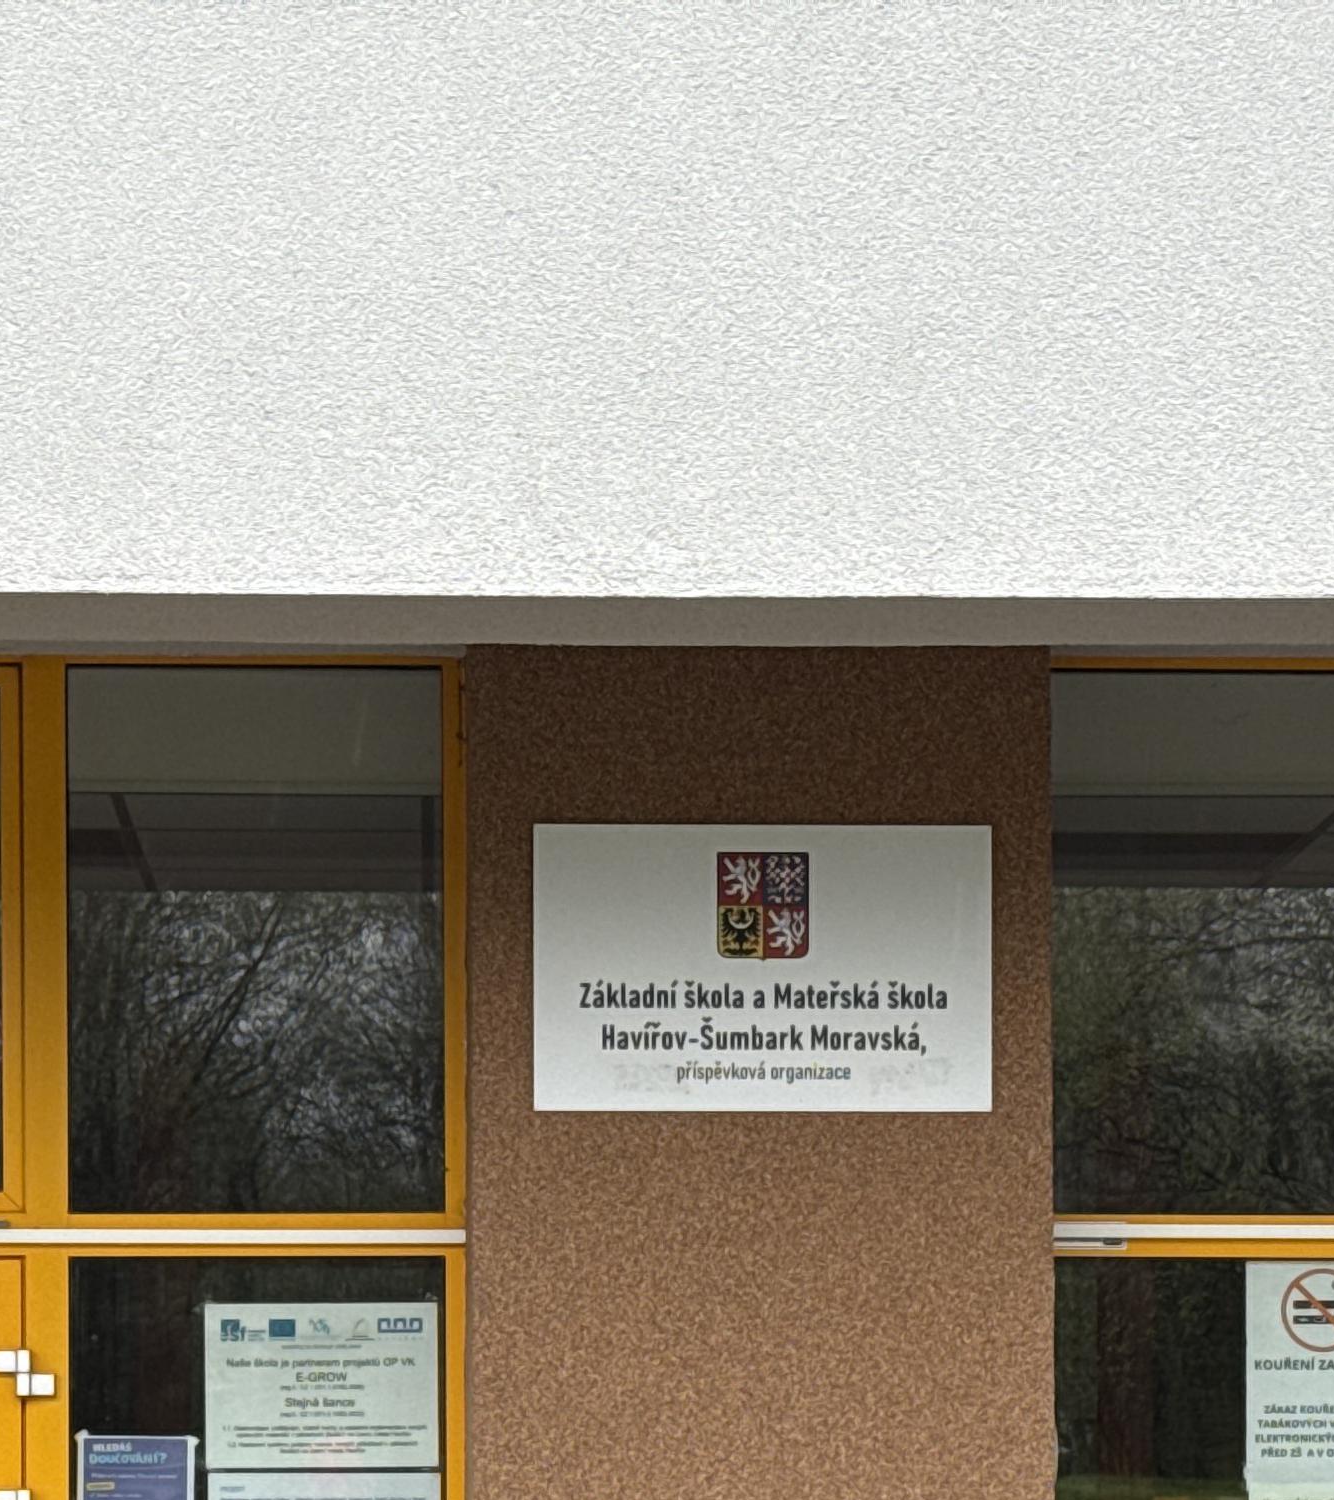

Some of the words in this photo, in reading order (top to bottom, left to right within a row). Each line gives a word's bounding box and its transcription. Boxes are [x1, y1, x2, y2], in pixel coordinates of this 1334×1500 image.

[579, 980, 677, 1010] Základní
[683, 980, 744, 1010] škola
[753, 988, 766, 1010] a
[774, 980, 878, 1010] Mateřská
[887, 980, 948, 1010] škola
[601, 1017, 802, 1052] Havířov-Šumbark
[811, 1022, 927, 1056] Moravská,
[677, 1060, 766, 1083] příspěvková
[771, 1064, 851, 1084] organizace
[226, 1358, 252, 1368] Naše
[253, 1358, 279, 1368] škola
[280, 1358, 290, 1369] je
[292, 1360, 341, 1369] partnerem
[401, 1357, 416, 1367] VK
[1254, 1357, 1315, 1371] KOUŘENÍ
[296, 1372, 348, 1382] E-GROW
[1263, 1403, 1298, 1415] ZÁKAZ
[1257, 1417, 1327, 1429] TABÁKOVÝCH
[1261, 1446, 1288, 1458] PŘED
[1290, 1446, 1302, 1458] ZŠ
[1306, 1448, 1314, 1458] A
[1316, 1448, 1324, 1458] V
